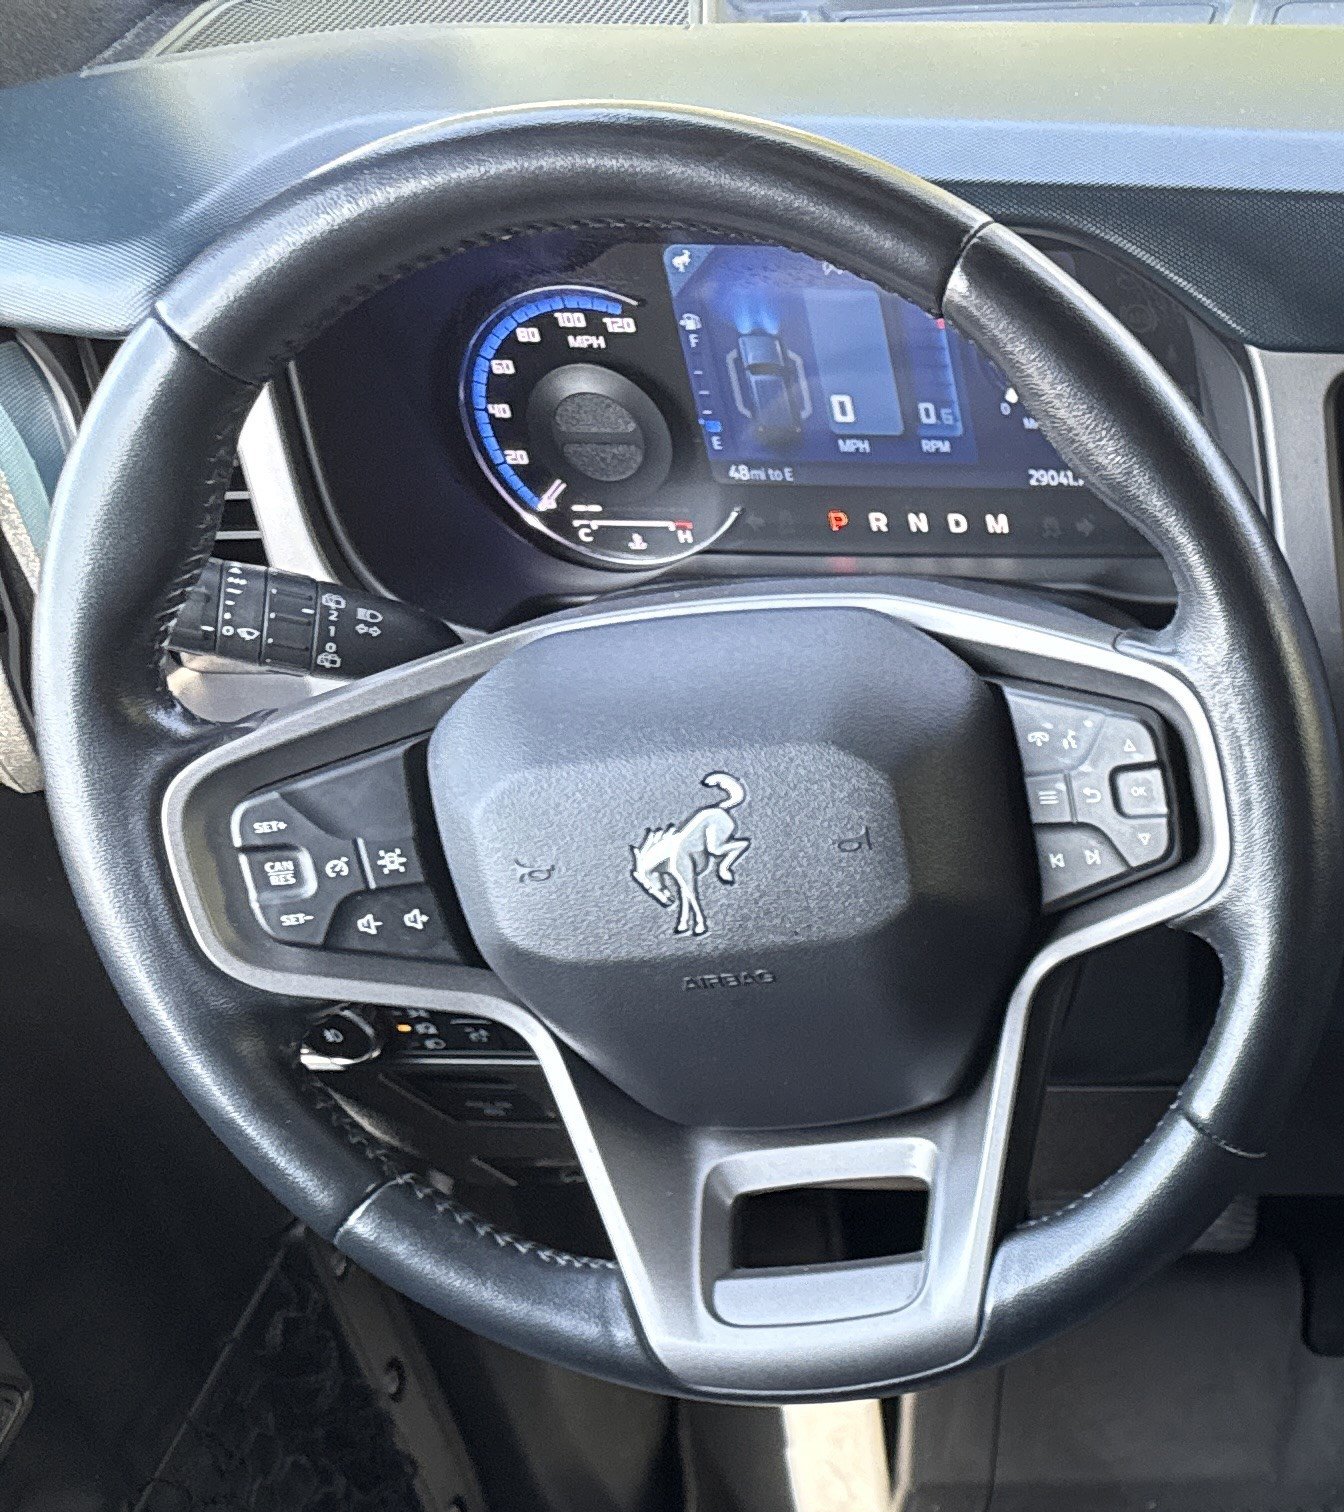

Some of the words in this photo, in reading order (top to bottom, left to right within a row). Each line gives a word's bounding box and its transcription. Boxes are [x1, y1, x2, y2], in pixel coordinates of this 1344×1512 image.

[554, 312, 586, 327] 100
[602, 317, 636, 332] 120
[515, 327, 541, 342] 80
[568, 335, 606, 348] MPH
[688, 334, 699, 347] F
[487, 403, 511, 418] 40
[830, 394, 855, 423] 0
[711, 435, 722, 450] E
[838, 439, 870, 453] MPH
[922, 439, 951, 453] RPM
[504, 450, 529, 464] 20
[827, 509, 849, 532] P
[868, 511, 888, 532] R
[908, 512, 928, 532] N
[947, 513, 968, 533] D
[985, 513, 1010, 534] M
[577, 528, 594, 542] C
[677, 528, 693, 543] H
[328, 610, 339, 621] 2
[1131, 786, 1147, 797] OK
[253, 821, 287, 833] SET+
[264, 861, 294, 872] CAN
[269, 874, 296, 885] RES
[682, 969, 776, 991] AIRBAG
